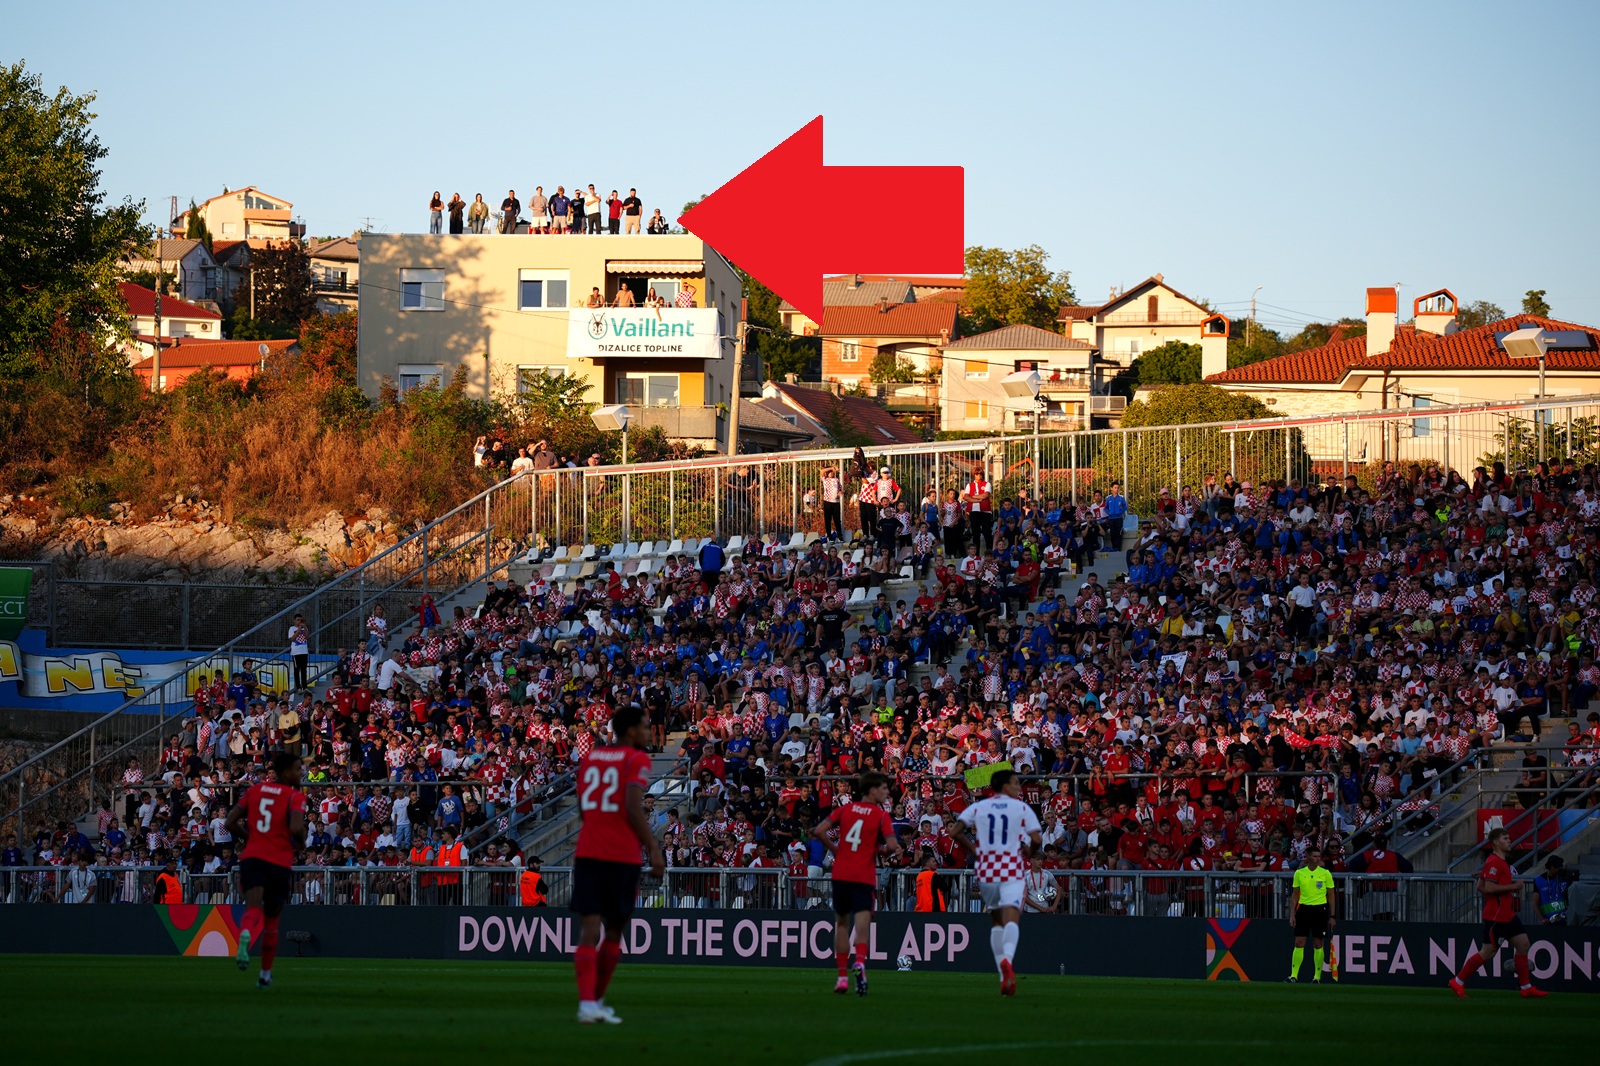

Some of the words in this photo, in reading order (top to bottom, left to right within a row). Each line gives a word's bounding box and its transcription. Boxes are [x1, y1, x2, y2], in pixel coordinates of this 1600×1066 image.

[611, 317, 695, 338] Vaillant
[598, 344, 641, 353] DIZALICE
[645, 344, 683, 353] TOPLINE
[581, 765, 619, 813] 22
[256, 797, 275, 834] 5
[851, 804, 872, 816] SCOTT
[845, 818, 864, 853] 4
[987, 813, 1009, 845] 11
[661, 918, 724, 956] THE
[898, 922, 970, 962] APP
